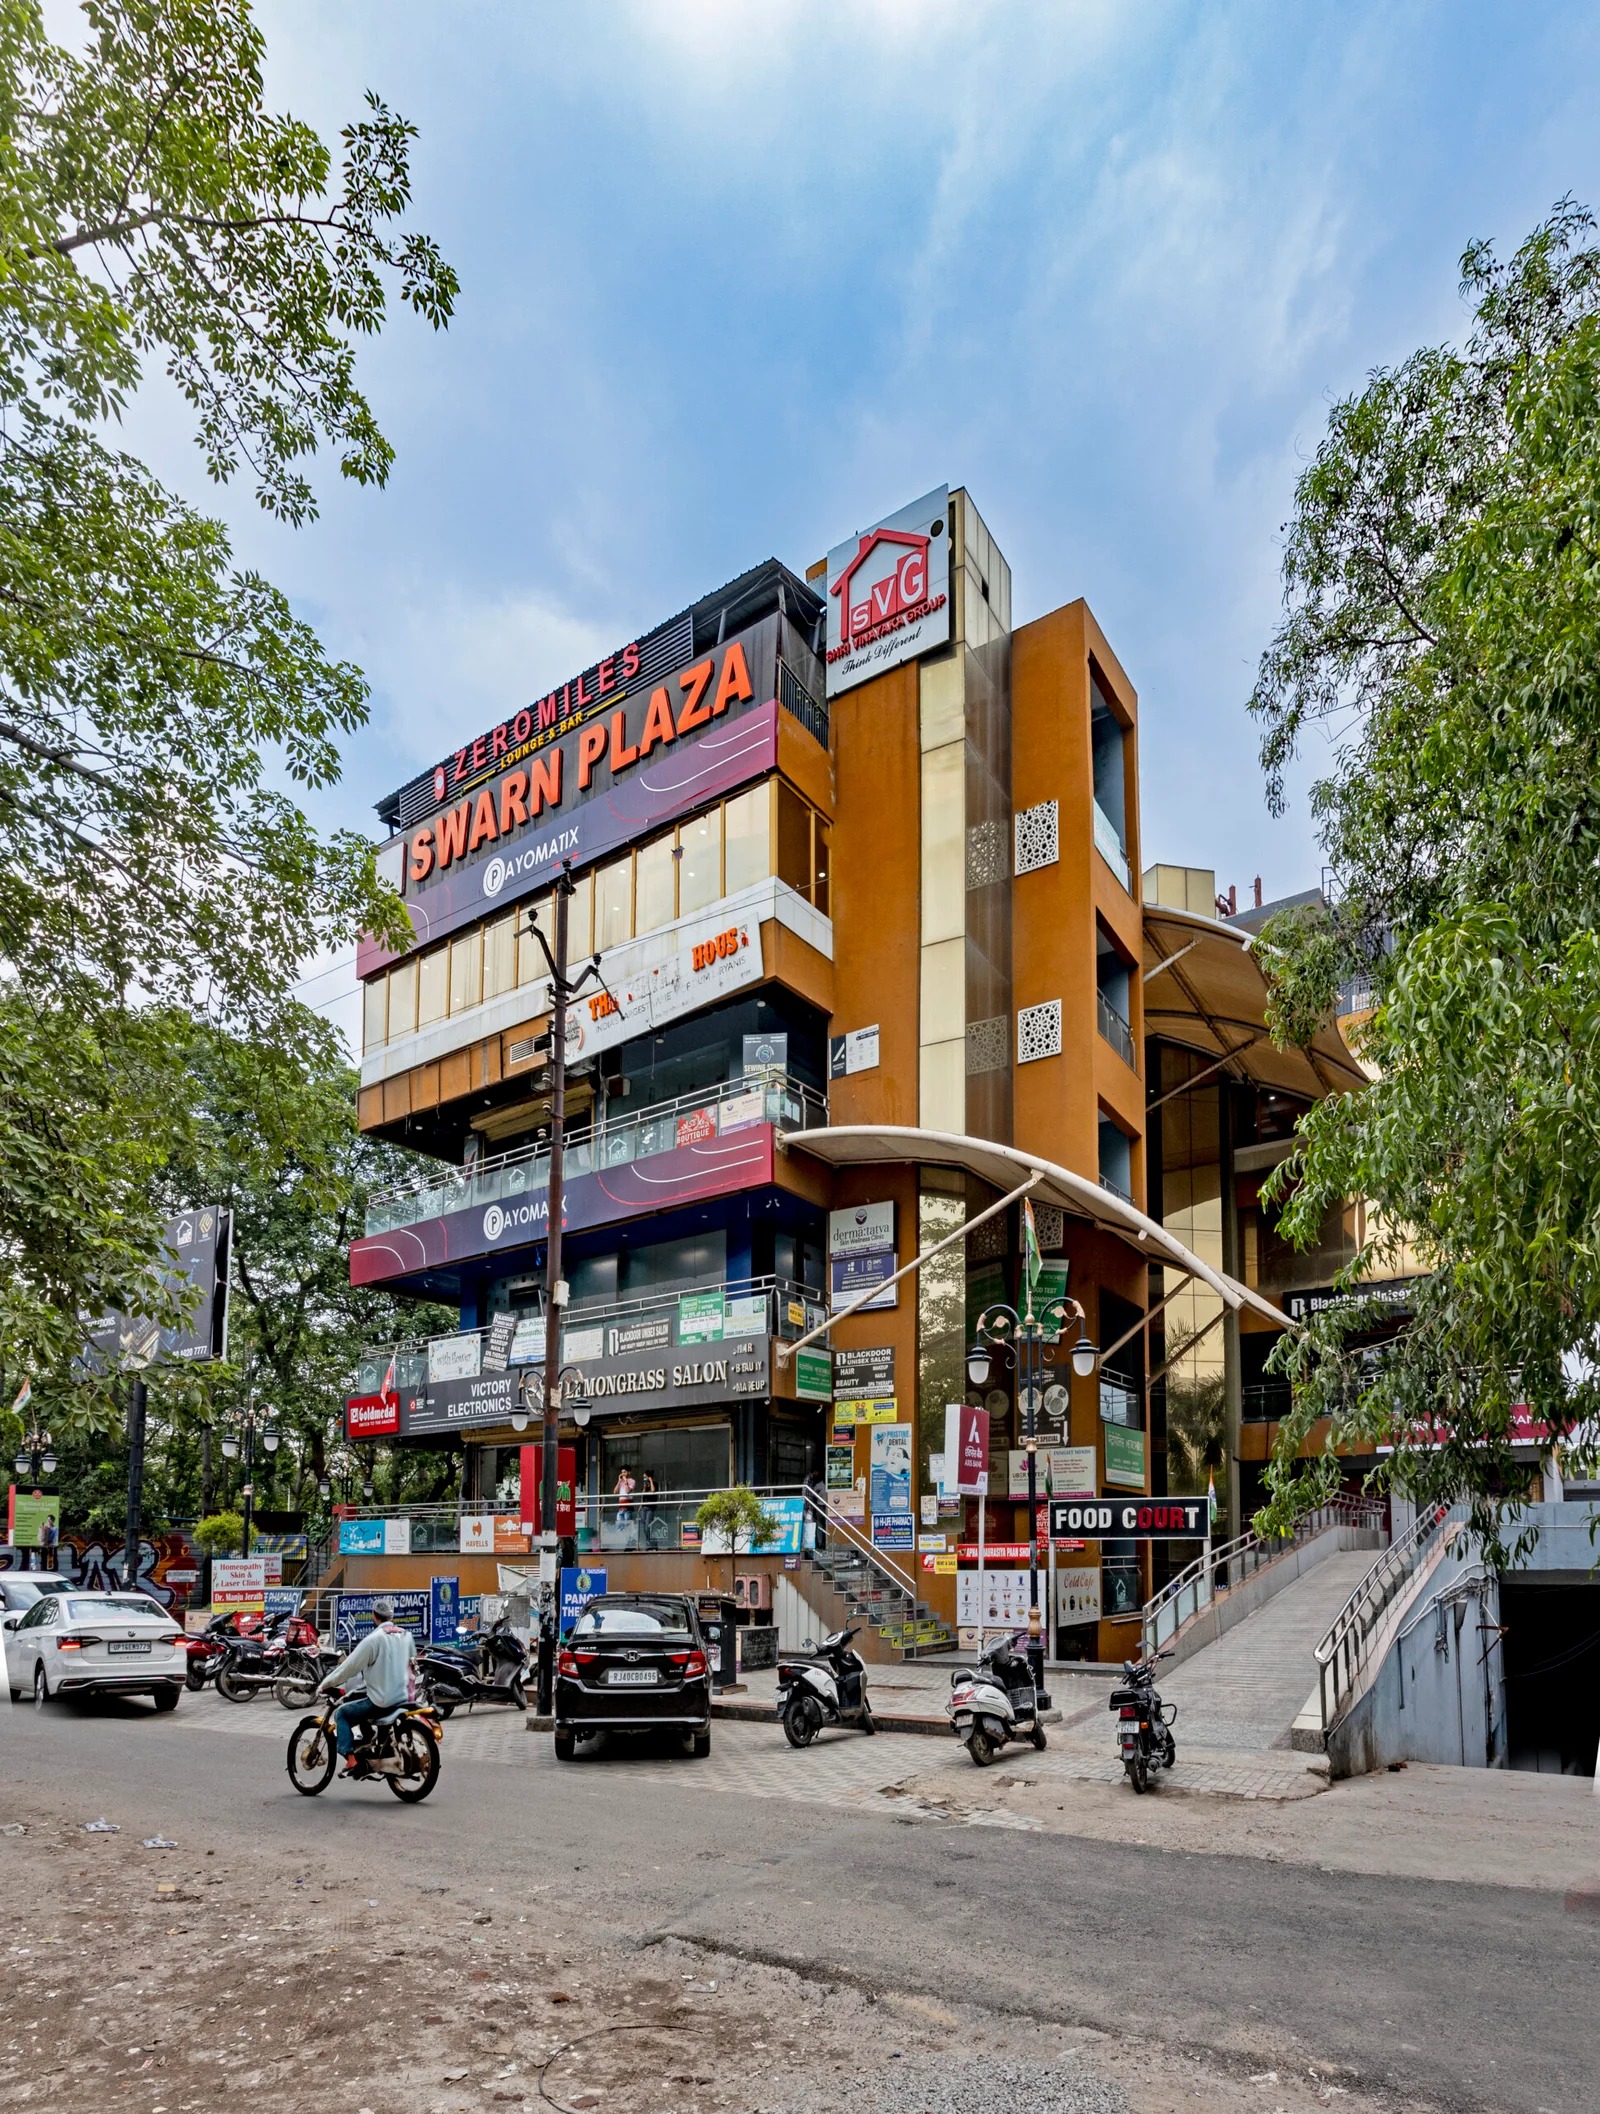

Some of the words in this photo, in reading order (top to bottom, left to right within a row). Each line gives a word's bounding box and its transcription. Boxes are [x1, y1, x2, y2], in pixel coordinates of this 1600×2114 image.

[826, 645, 851, 664] SHRI
[853, 620, 906, 650] VINAYAKA
[906, 593, 947, 624] GROUP
[842, 652, 872, 675] Think
[874, 625, 923, 661] Different
[453, 642, 642, 782] ZEROMILES
[501, 734, 545, 770] LOUNGE
[548, 728, 557, 741] &
[560, 711, 584, 733] BAR
[410, 747, 563, 882] SWARN
[577, 642, 754, 792] PLAZA
[482, 826, 580, 898] PAYOMATIX
[676, 1128, 710, 1143] BOUTIQUE
[483, 1195, 567, 1240] PAYOMAX
[847, 1348, 892, 1359] BLACKDOOR
[673, 1359, 729, 1388] SALON
[840, 1368, 855, 1376] HAIR
[471, 1379, 512, 1397] VICTORY
[836, 1378, 859, 1387] BEAUTY
[359, 1402, 396, 1421] Goldmedal
[447, 1397, 512, 1418] ELECTRONICS
[886, 1430, 909, 1438] PRISTINE
[888, 1438, 907, 1446] DENTAL
[1055, 1507, 1113, 1529] FOOD
[1121, 1506, 1200, 1529] COURT
[465, 1540, 489, 1548] HAVELLS
[220, 1563, 262, 1571] Homeopathy
[230, 1571, 246, 1579] Skin
[214, 1593, 225, 1602] Dr.
[225, 1592, 244, 1603] Manju
[245, 1592, 263, 1601] Jerath
